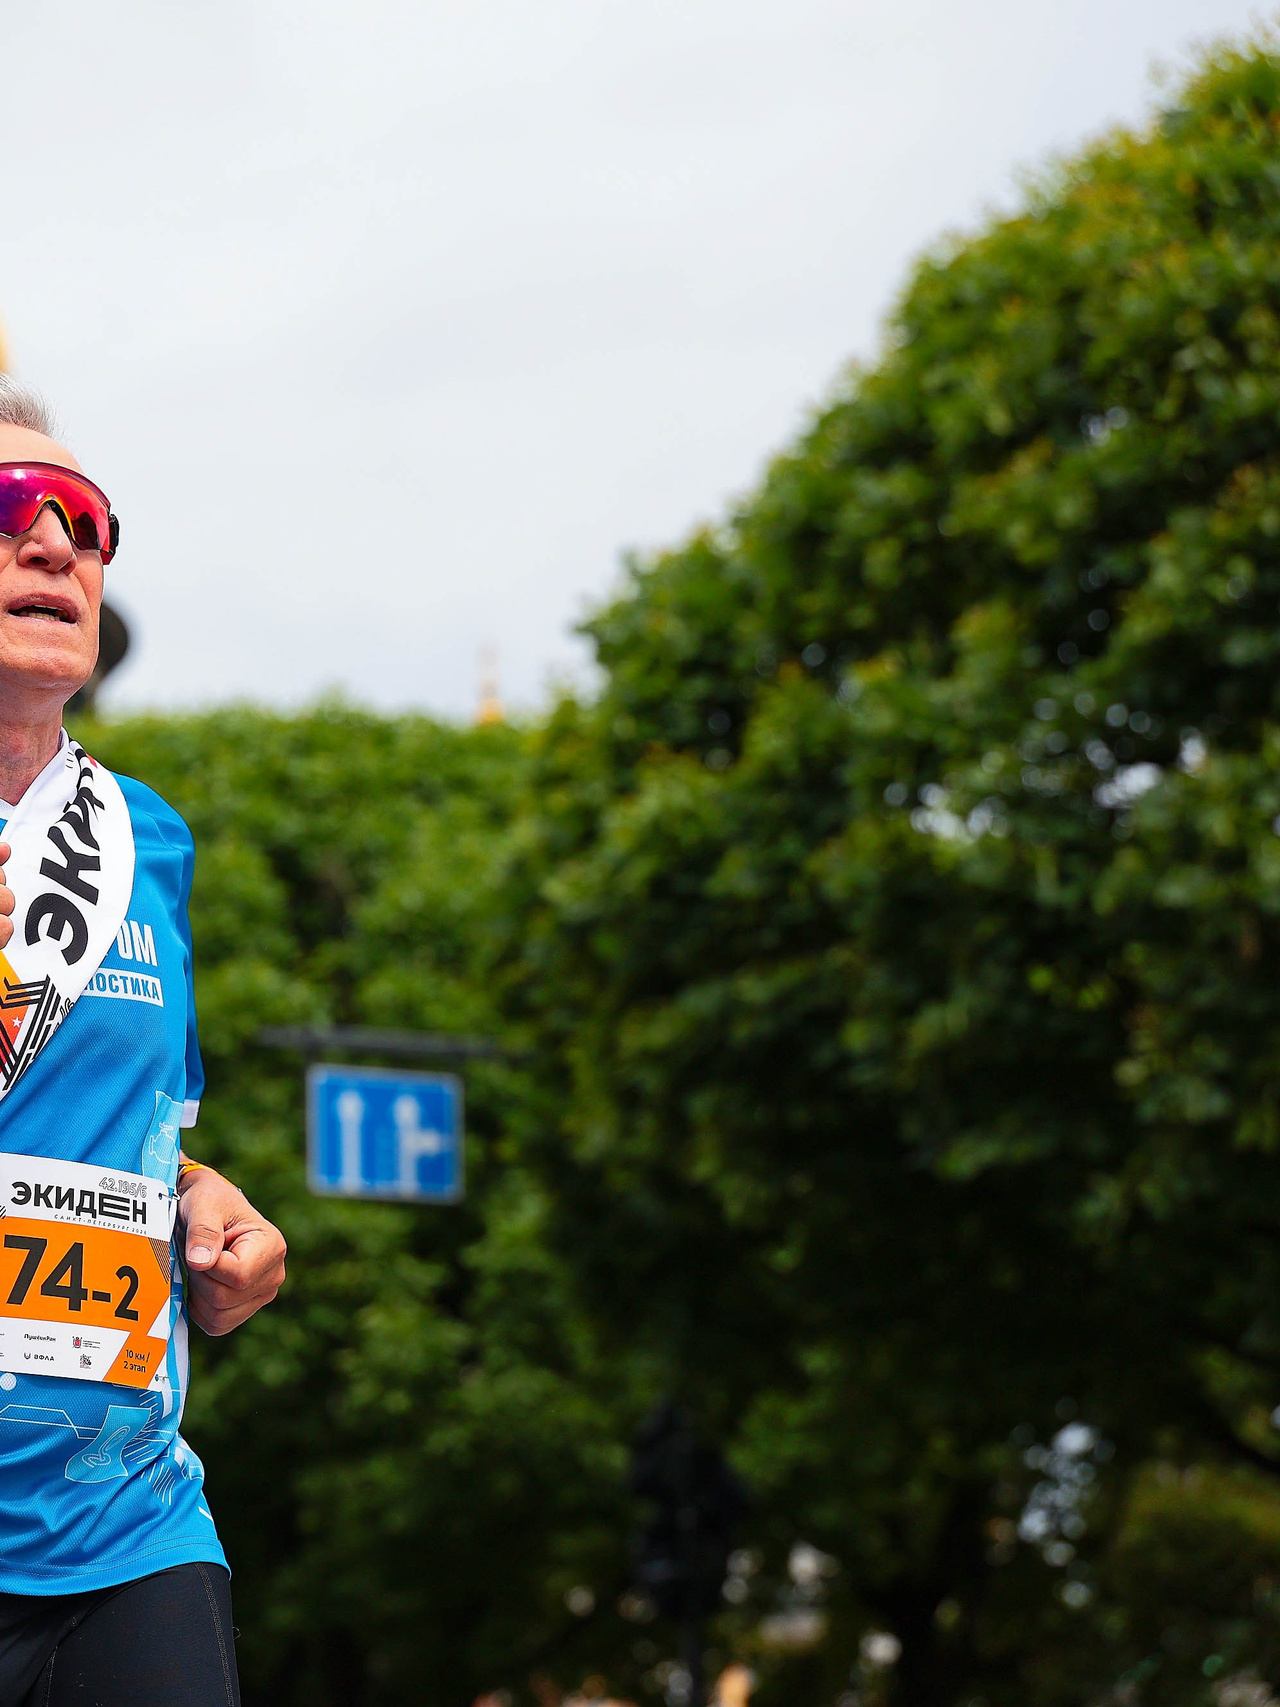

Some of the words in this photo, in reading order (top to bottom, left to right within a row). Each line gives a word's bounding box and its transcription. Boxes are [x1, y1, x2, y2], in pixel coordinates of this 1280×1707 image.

[116, 920, 158, 967] ОМ
[10, 1181, 147, 1225] ЭКИДЕН
[99, 1176, 148, 1199] 42.195/6
[4, 1234, 139, 1321] 74-2
[123, 1360, 129, 1369] 2
[129, 1363, 146, 1373] этап
[126, 1349, 134, 1358] 10
[135, 1352, 145, 1361] км
